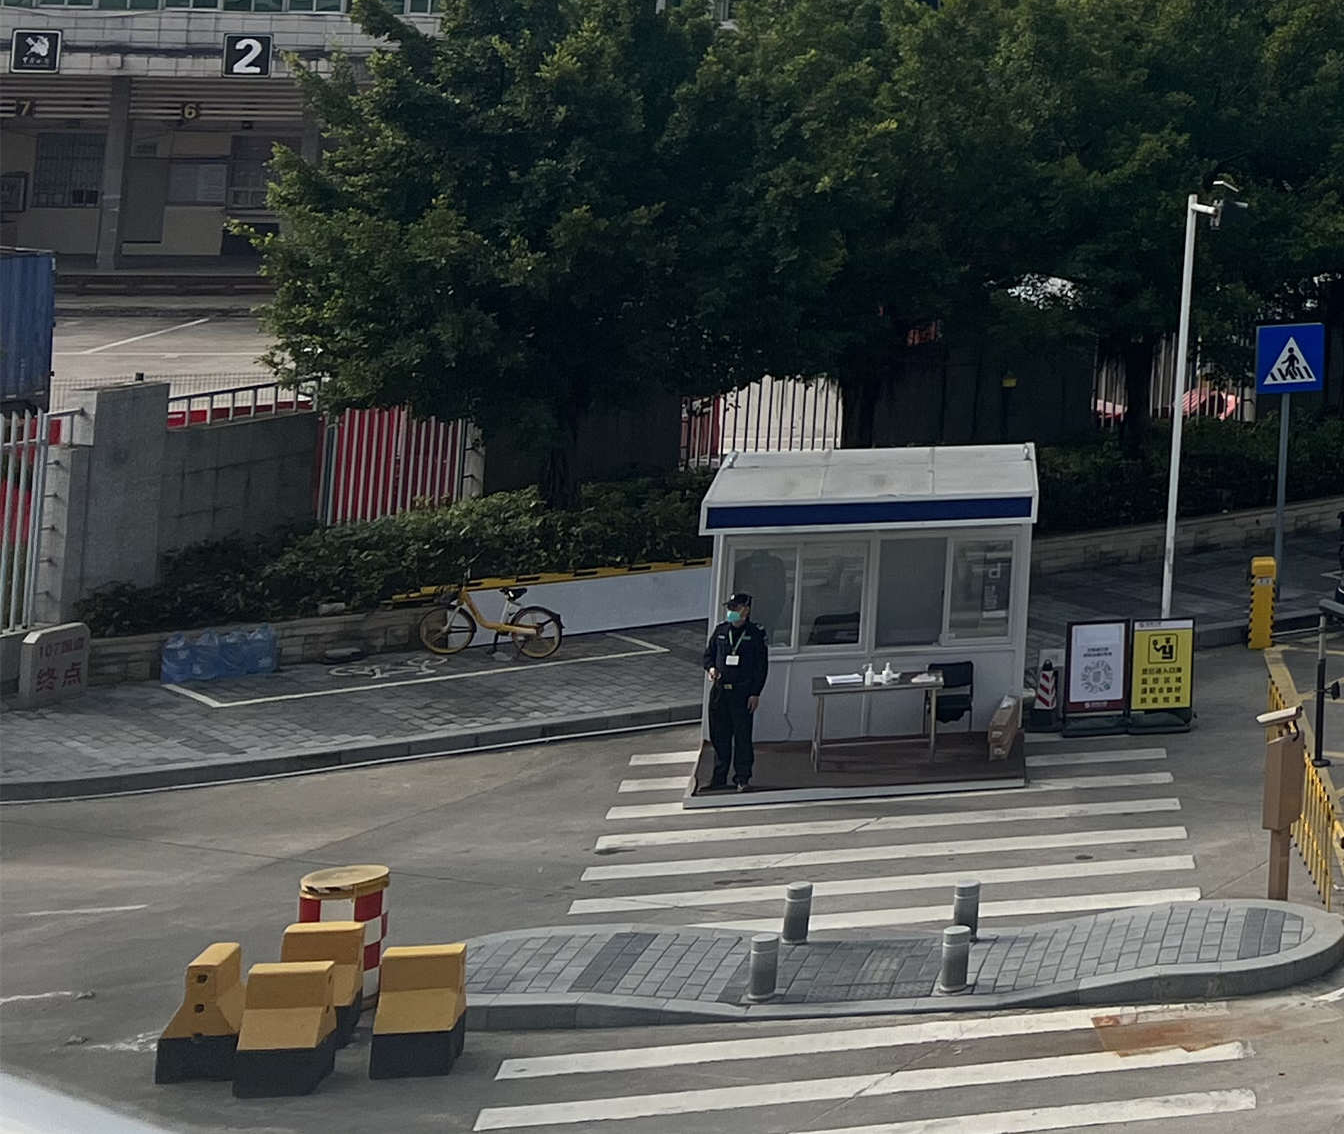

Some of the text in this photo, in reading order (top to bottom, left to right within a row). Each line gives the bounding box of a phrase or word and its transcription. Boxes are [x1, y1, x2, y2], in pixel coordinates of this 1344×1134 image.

[232, 38, 262, 74] 2
[19, 101, 31, 116] 7
[184, 103, 197, 119] 6
